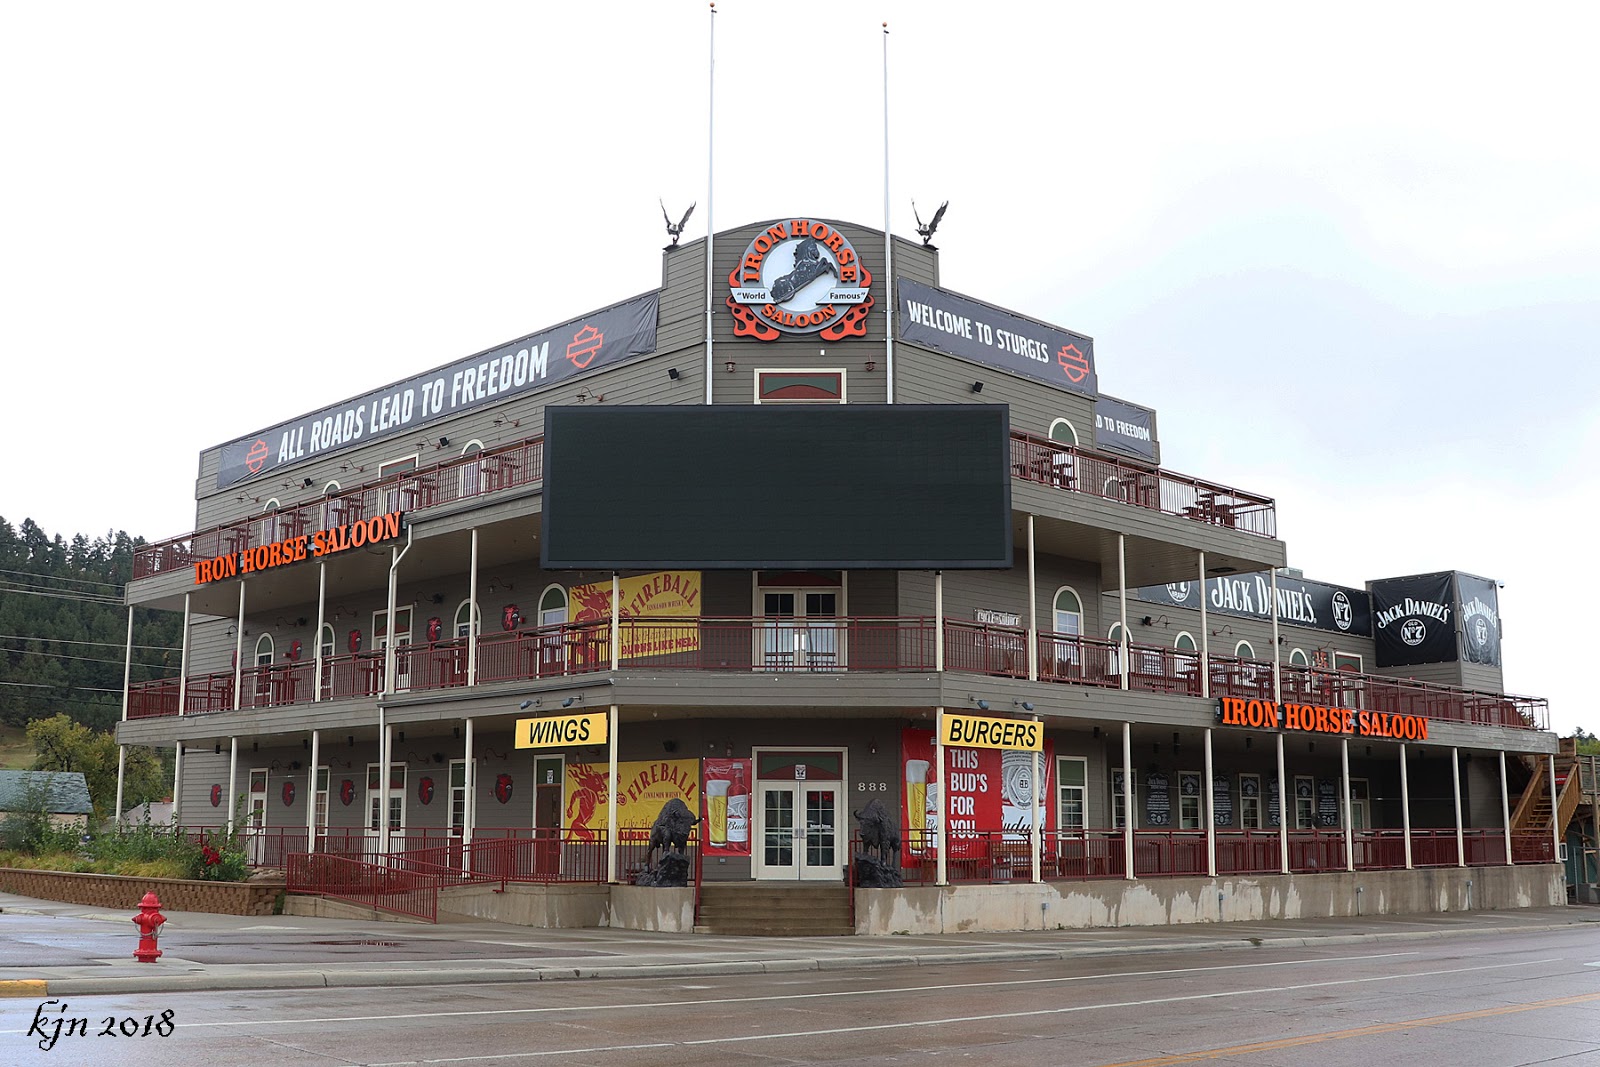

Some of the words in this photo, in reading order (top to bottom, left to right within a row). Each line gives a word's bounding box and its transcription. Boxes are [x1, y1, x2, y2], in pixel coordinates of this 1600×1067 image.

[743, 223, 788, 283] IRON
[791, 219, 858, 283] HORSE
[761, 303, 837, 328] SALOON
[906, 299, 973, 340] WELCOME
[975, 321, 993, 346] TO
[996, 328, 1050, 364] STURGIS
[276, 430, 305, 464] ALL
[309, 404, 366, 452] ROADS
[369, 387, 415, 433] LEAD
[421, 377, 446, 417] TO
[450, 341, 551, 408] FREEDOM
[1095, 414, 1103, 429] D
[1103, 416, 1114, 432] TO
[1115, 420, 1151, 442] FREEDOM
[193, 553, 238, 585] IRON
[241, 535, 308, 574] HORSE
[312, 511, 401, 557] SALOON
[629, 573, 699, 617] FIREBALL
[1210, 577, 1254, 613] JACK
[1376, 603, 1405, 629] JACK
[1404, 598, 1451, 623] DANIEL'S
[529, 718, 591, 744] WINGS
[949, 718, 1037, 747] BURGERS
[1222, 697, 1279, 728] IRON
[1284, 703, 1355, 734] HORSE
[1359, 710, 1429, 740] SALOON
[950, 749, 979, 769] THIS
[627, 762, 697, 803] FIREBALL
[857, 782, 887, 791] 888
[950, 772, 988, 793] BUD'S
[950, 796, 975, 816] FOR
[618, 831, 650, 840] BURNS
[950, 819, 980, 839] YOU.
